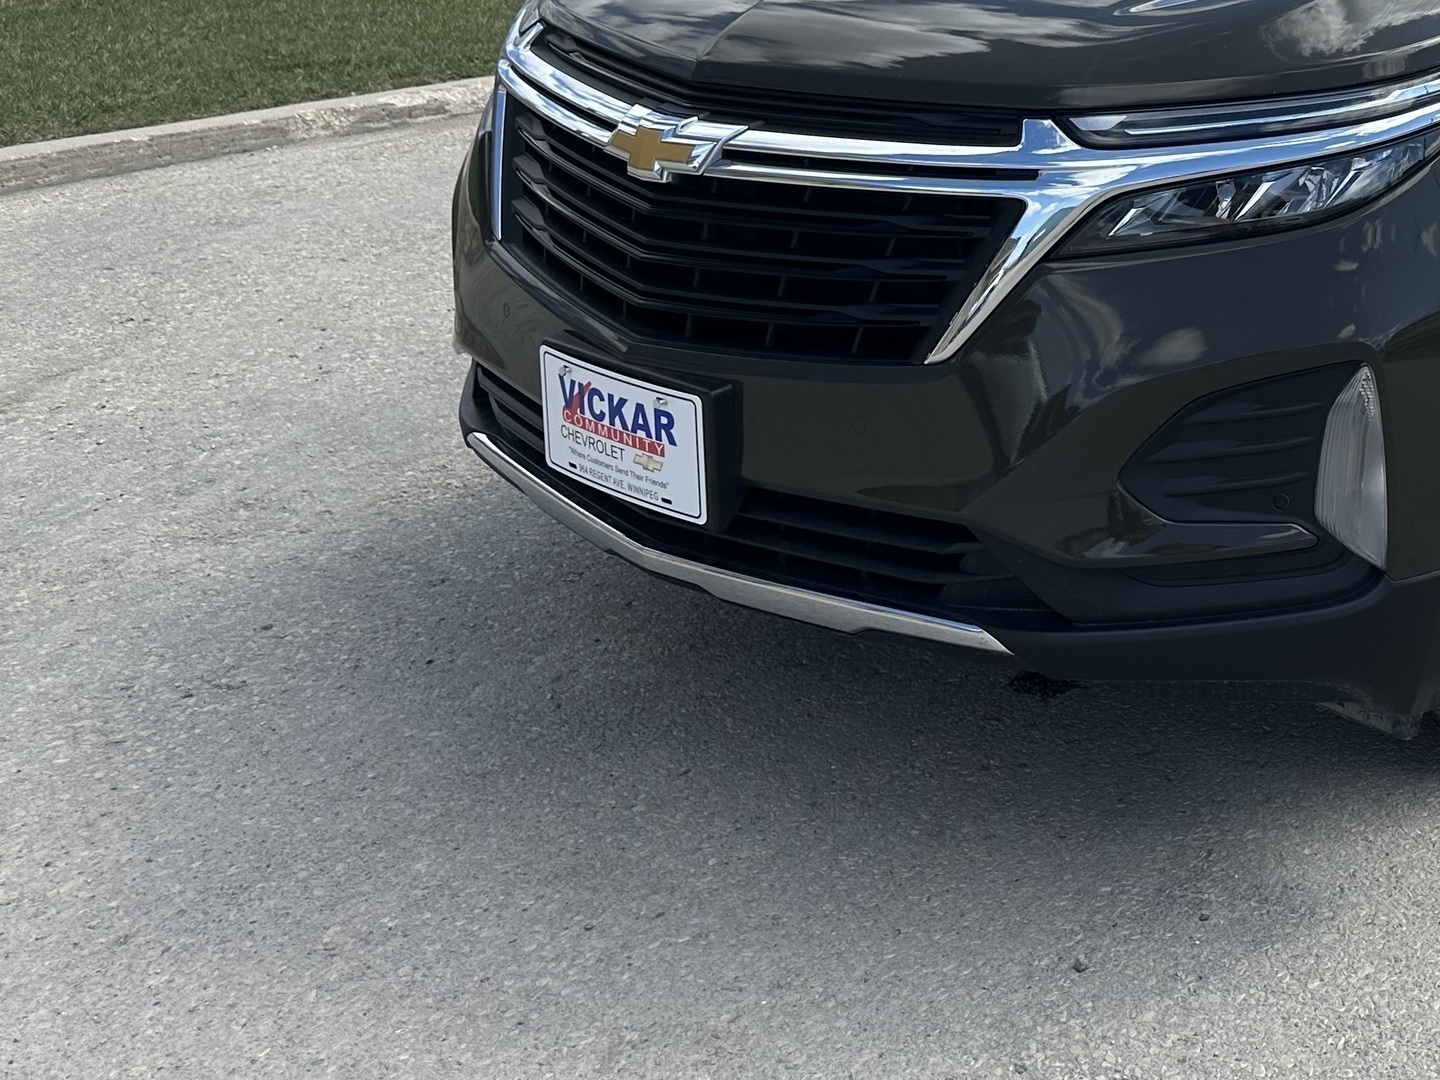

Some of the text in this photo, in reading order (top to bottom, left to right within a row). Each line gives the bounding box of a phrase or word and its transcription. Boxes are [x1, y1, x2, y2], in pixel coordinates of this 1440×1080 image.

[558, 373, 678, 447] VICKAR
[560, 424, 625, 461] CHEVROLET
[563, 409, 664, 456] COMMUNITY
[589, 468, 612, 485] REGENT
[626, 482, 659, 501] WINNIPEG
